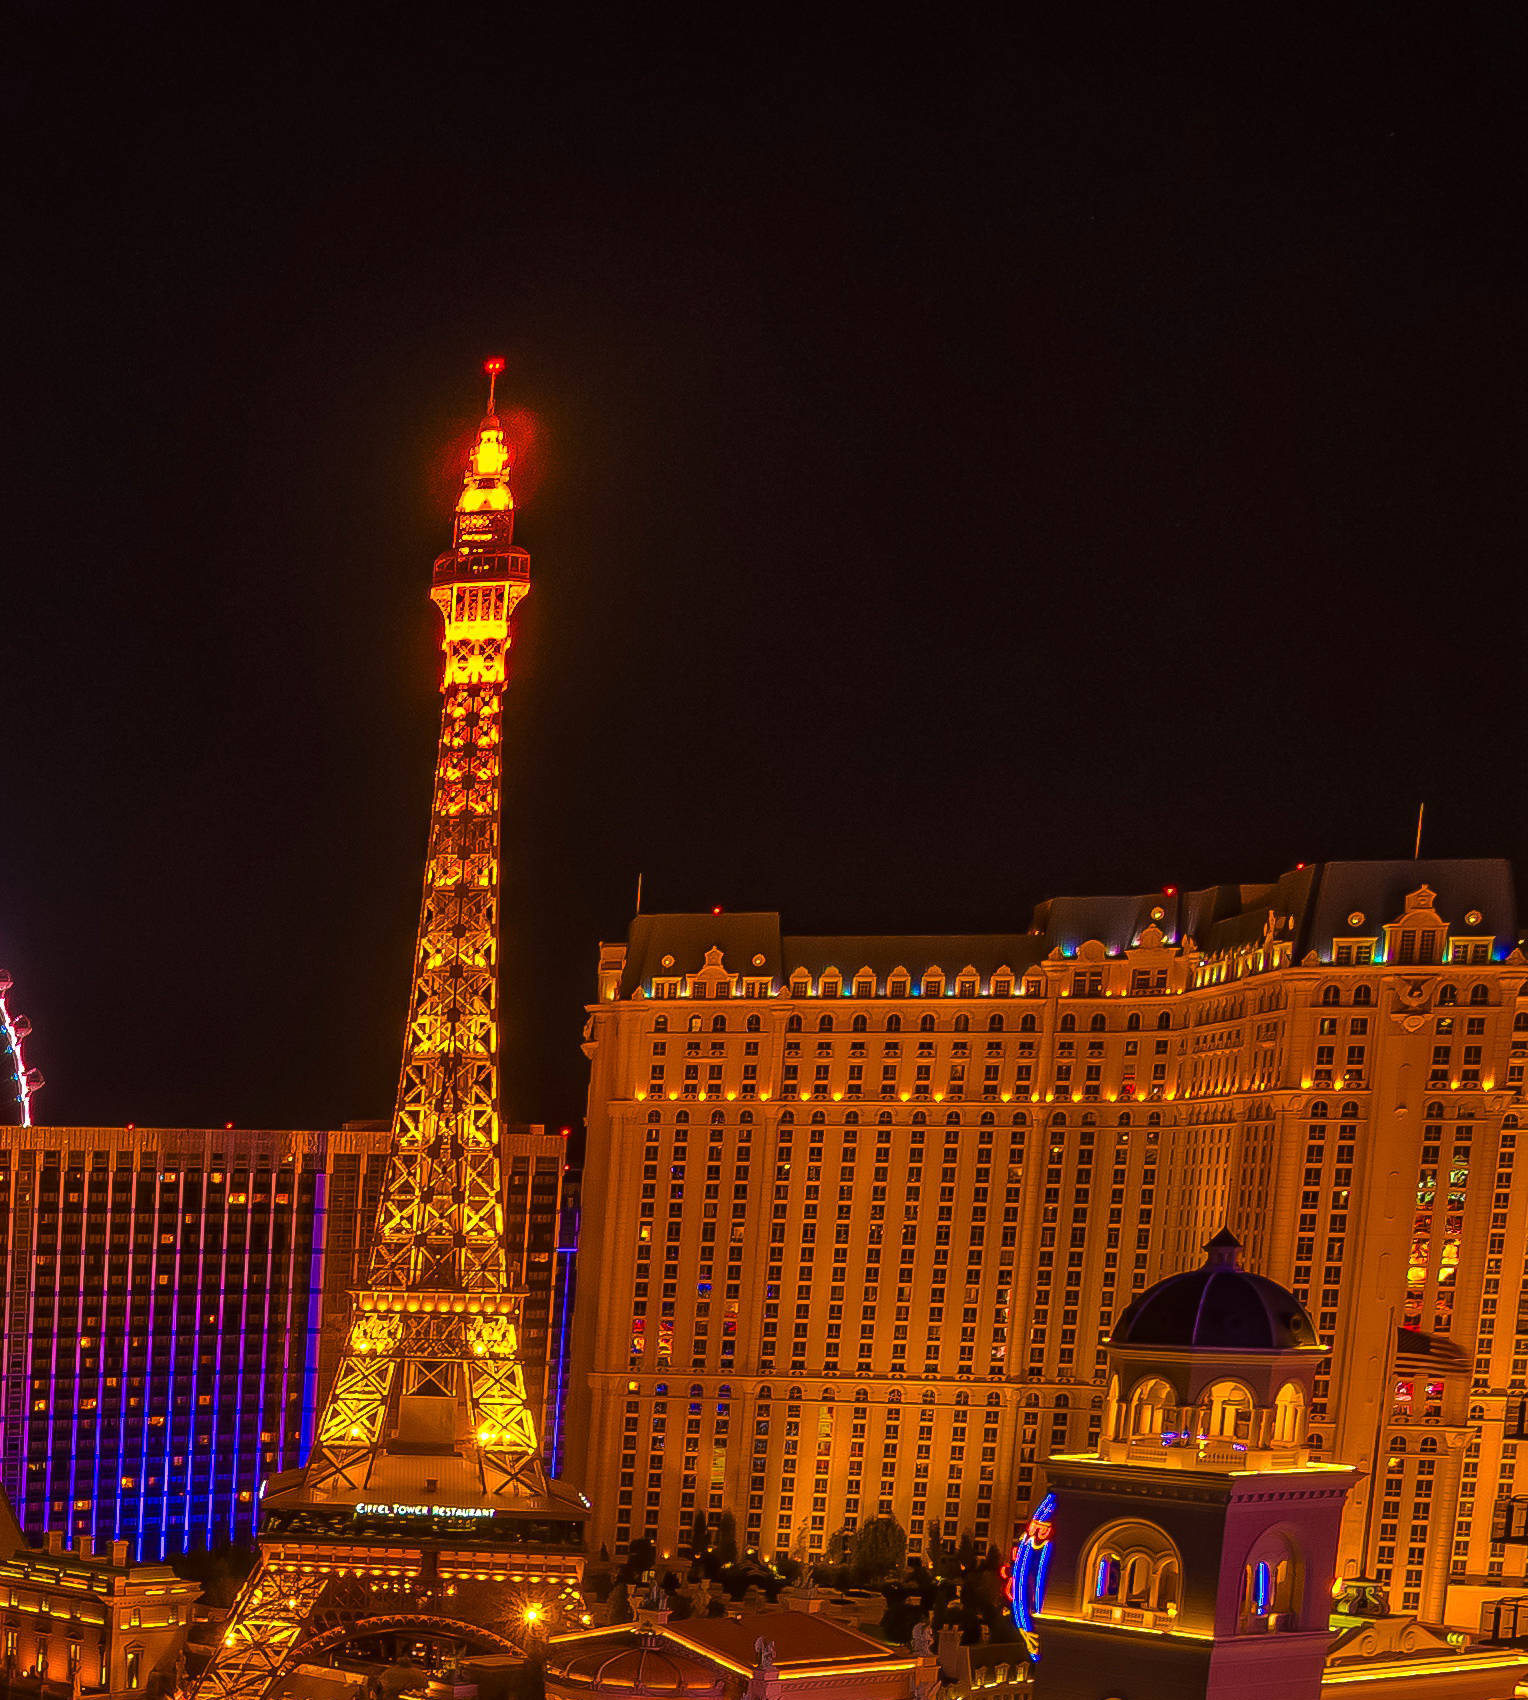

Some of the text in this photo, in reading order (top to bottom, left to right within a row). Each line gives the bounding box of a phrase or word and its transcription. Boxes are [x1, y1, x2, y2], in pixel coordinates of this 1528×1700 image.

[355, 1502, 496, 1519] EIFFEL TOWER RESTAURANT
